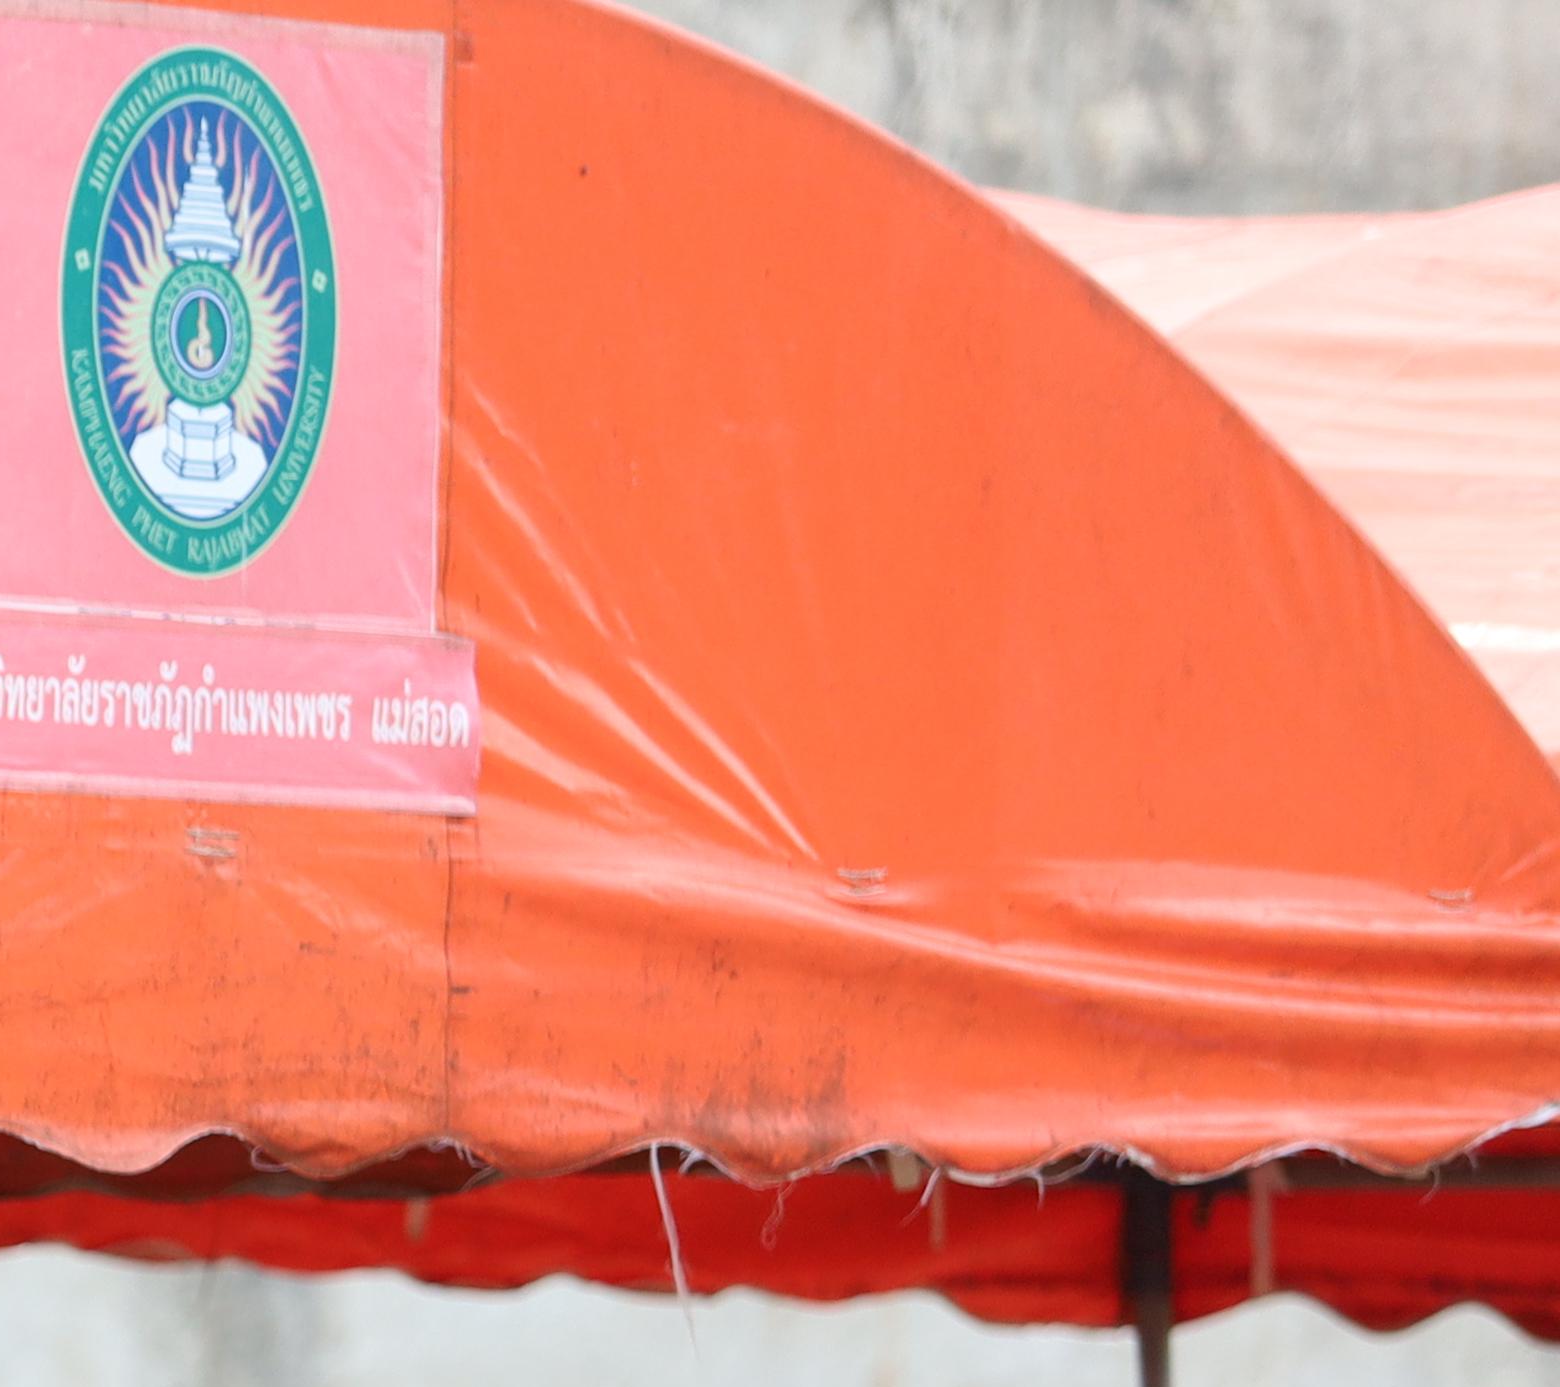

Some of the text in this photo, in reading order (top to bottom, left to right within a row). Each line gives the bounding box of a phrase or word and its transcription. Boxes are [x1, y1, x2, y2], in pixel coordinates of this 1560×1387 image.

[131, 504, 180, 554] PHET
[370, 678, 470, 749] แม่สอด
